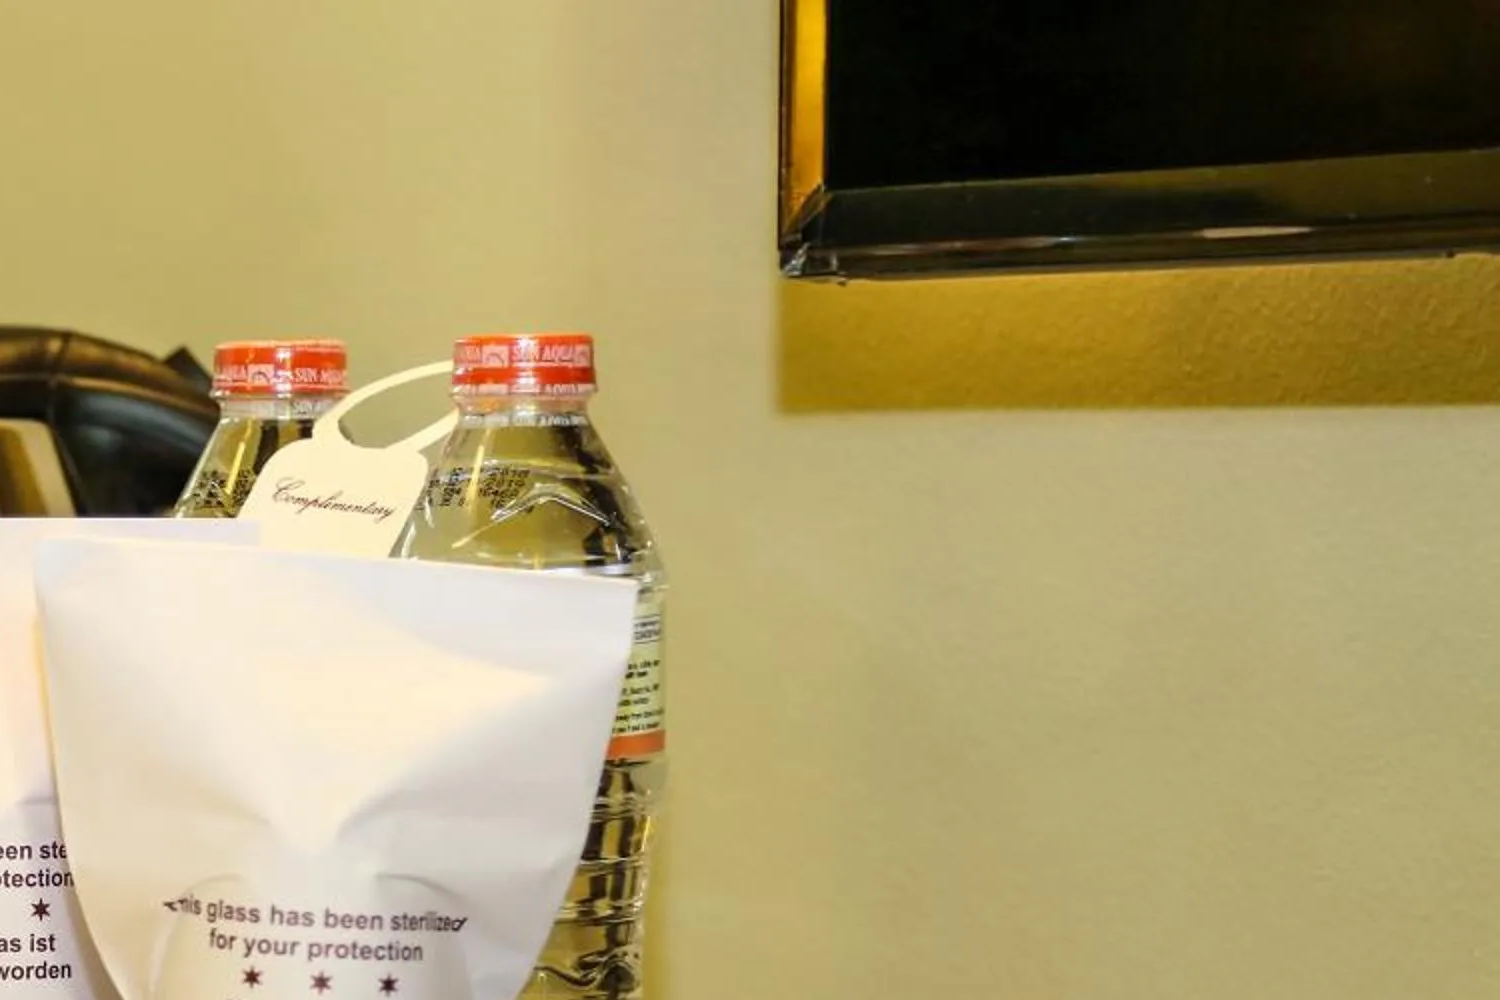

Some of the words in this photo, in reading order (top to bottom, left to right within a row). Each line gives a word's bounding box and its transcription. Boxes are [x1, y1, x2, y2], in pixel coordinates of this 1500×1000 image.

[272, 477, 396, 524] Complimentary
[206, 900, 261, 924] glass
[270, 904, 316, 928] has
[324, 908, 384, 931] been
[390, 910, 469, 933] sterilized
[29, 933, 57, 952] ist
[209, 927, 237, 951] for
[243, 937, 300, 959] your
[307, 939, 424, 962] protection
